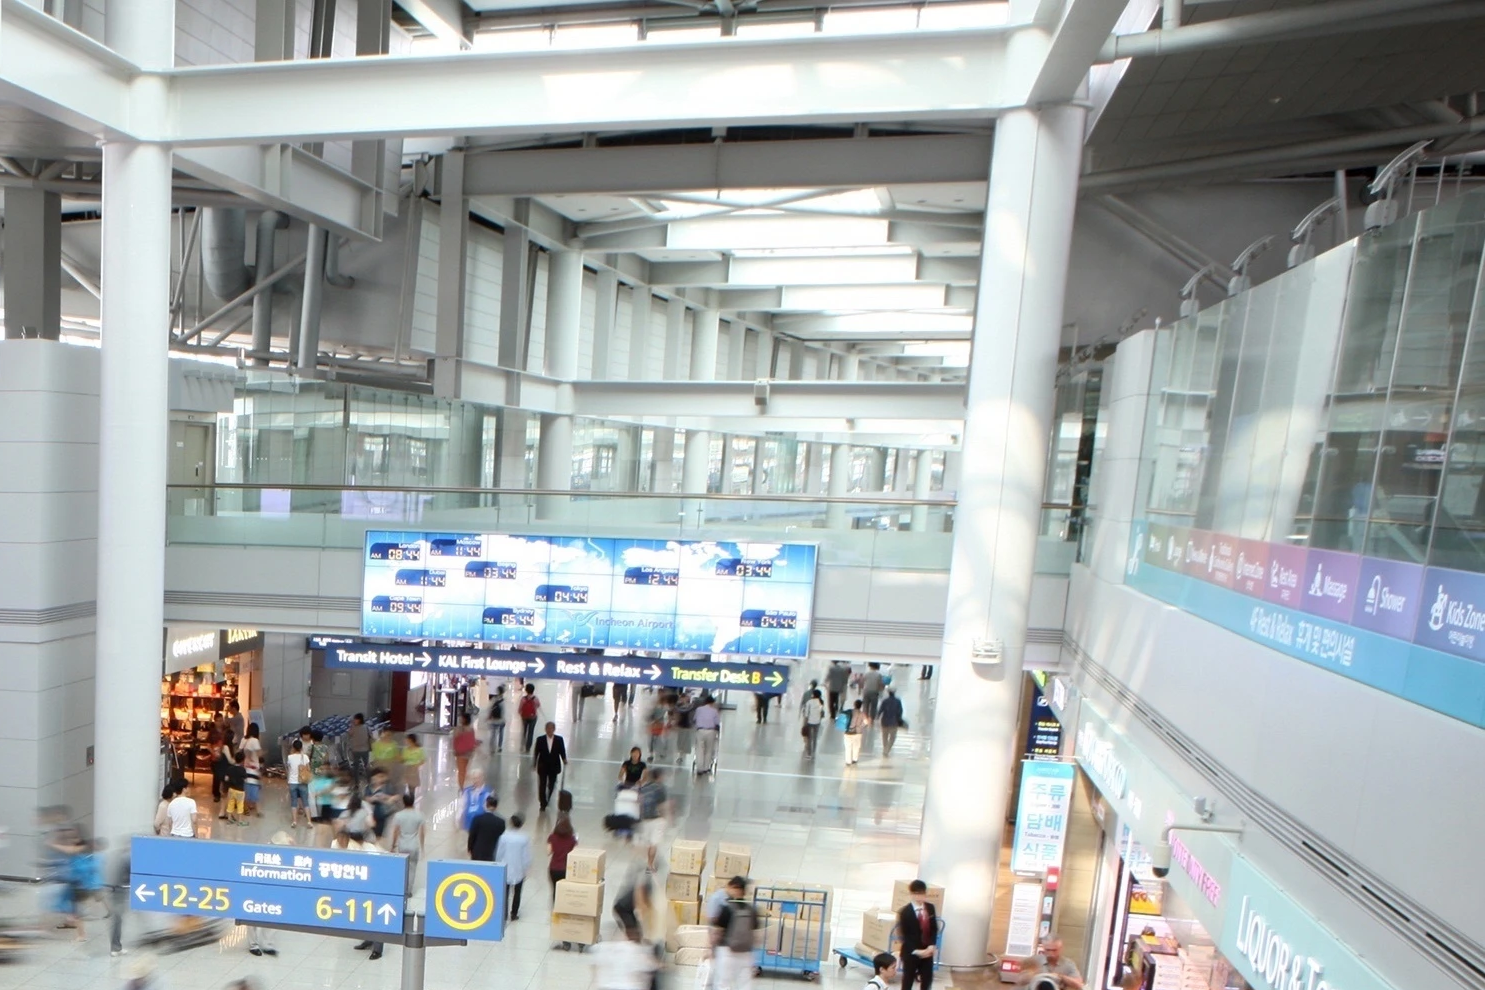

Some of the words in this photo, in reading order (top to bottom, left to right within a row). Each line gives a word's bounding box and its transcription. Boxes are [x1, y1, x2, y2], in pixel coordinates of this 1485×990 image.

[388, 549, 420, 560] 08:44
[1380, 587, 1406, 612] Shower
[595, 617, 635, 627] Incheon
[638, 618, 673, 630] Airport
[1446, 601, 1465, 628] Kids
[1464, 604, 1485, 632] Zone
[337, 650, 377, 664] Transit
[380, 652, 413, 665] Hotel
[438, 656, 459, 668] KAL
[461, 657, 484, 670] First
[487, 658, 527, 674] Lounge
[557, 660, 585, 675] Rest
[589, 662, 600, 675] &
[603, 663, 640, 678] Relax
[671, 667, 719, 683] Transfer
[721, 670, 749, 684] Desk
[751, 671, 761, 684] B
[1026, 813, 1063, 831] 담배
[1022, 843, 1058, 860] 식품
[240, 865, 312, 882] Information
[159, 883, 230, 911] 12-25
[243, 900, 282, 916] Gates
[316, 896, 372, 924] 6-11
